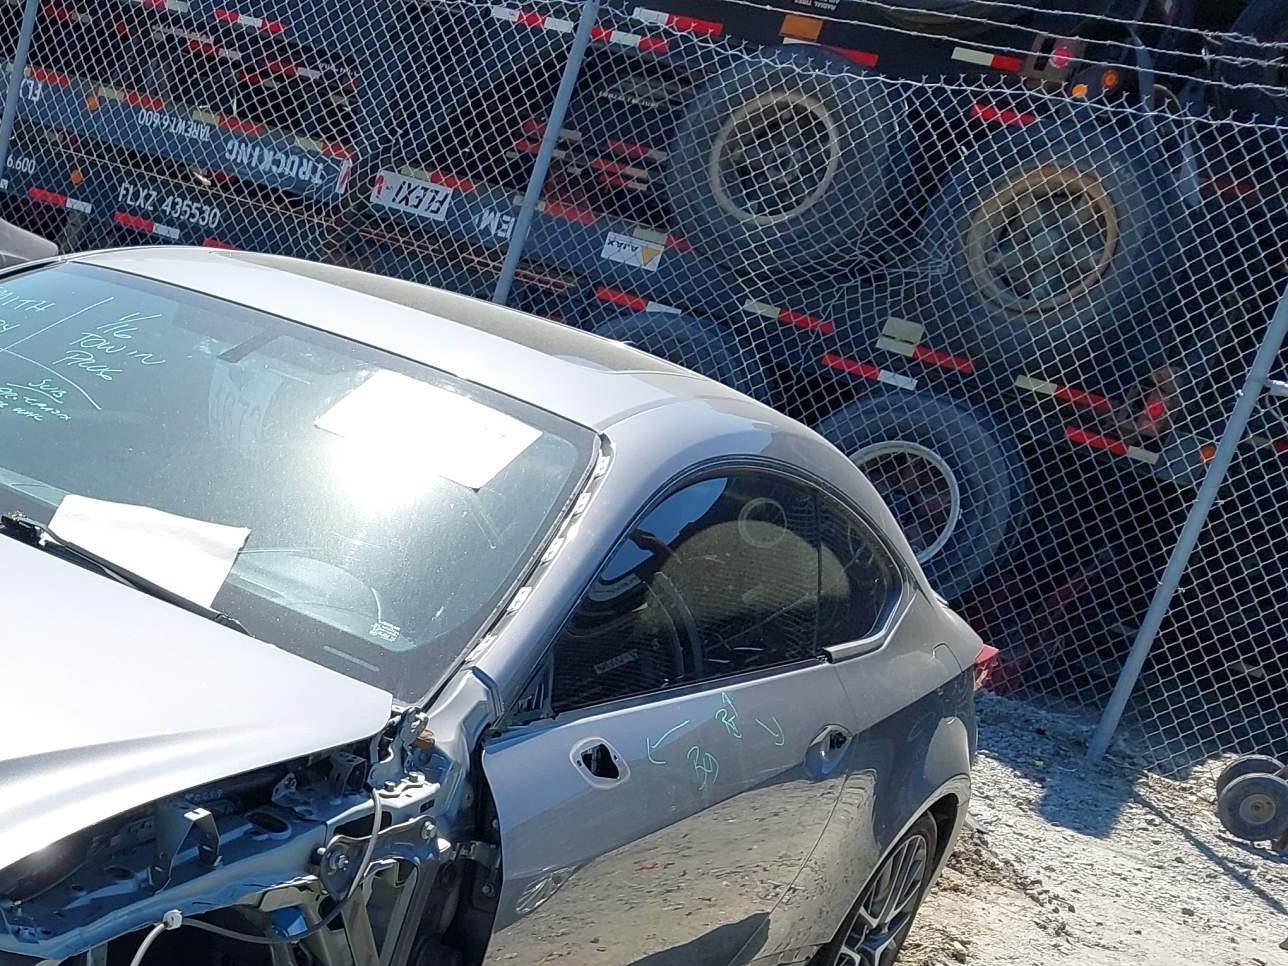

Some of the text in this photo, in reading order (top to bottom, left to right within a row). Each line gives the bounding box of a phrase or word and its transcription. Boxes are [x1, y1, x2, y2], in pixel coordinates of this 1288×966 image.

[225, 140, 324, 185] TRUCKING
[118, 182, 221, 228] FLXZ 435530
[606, 240, 640, 252] AJAX
